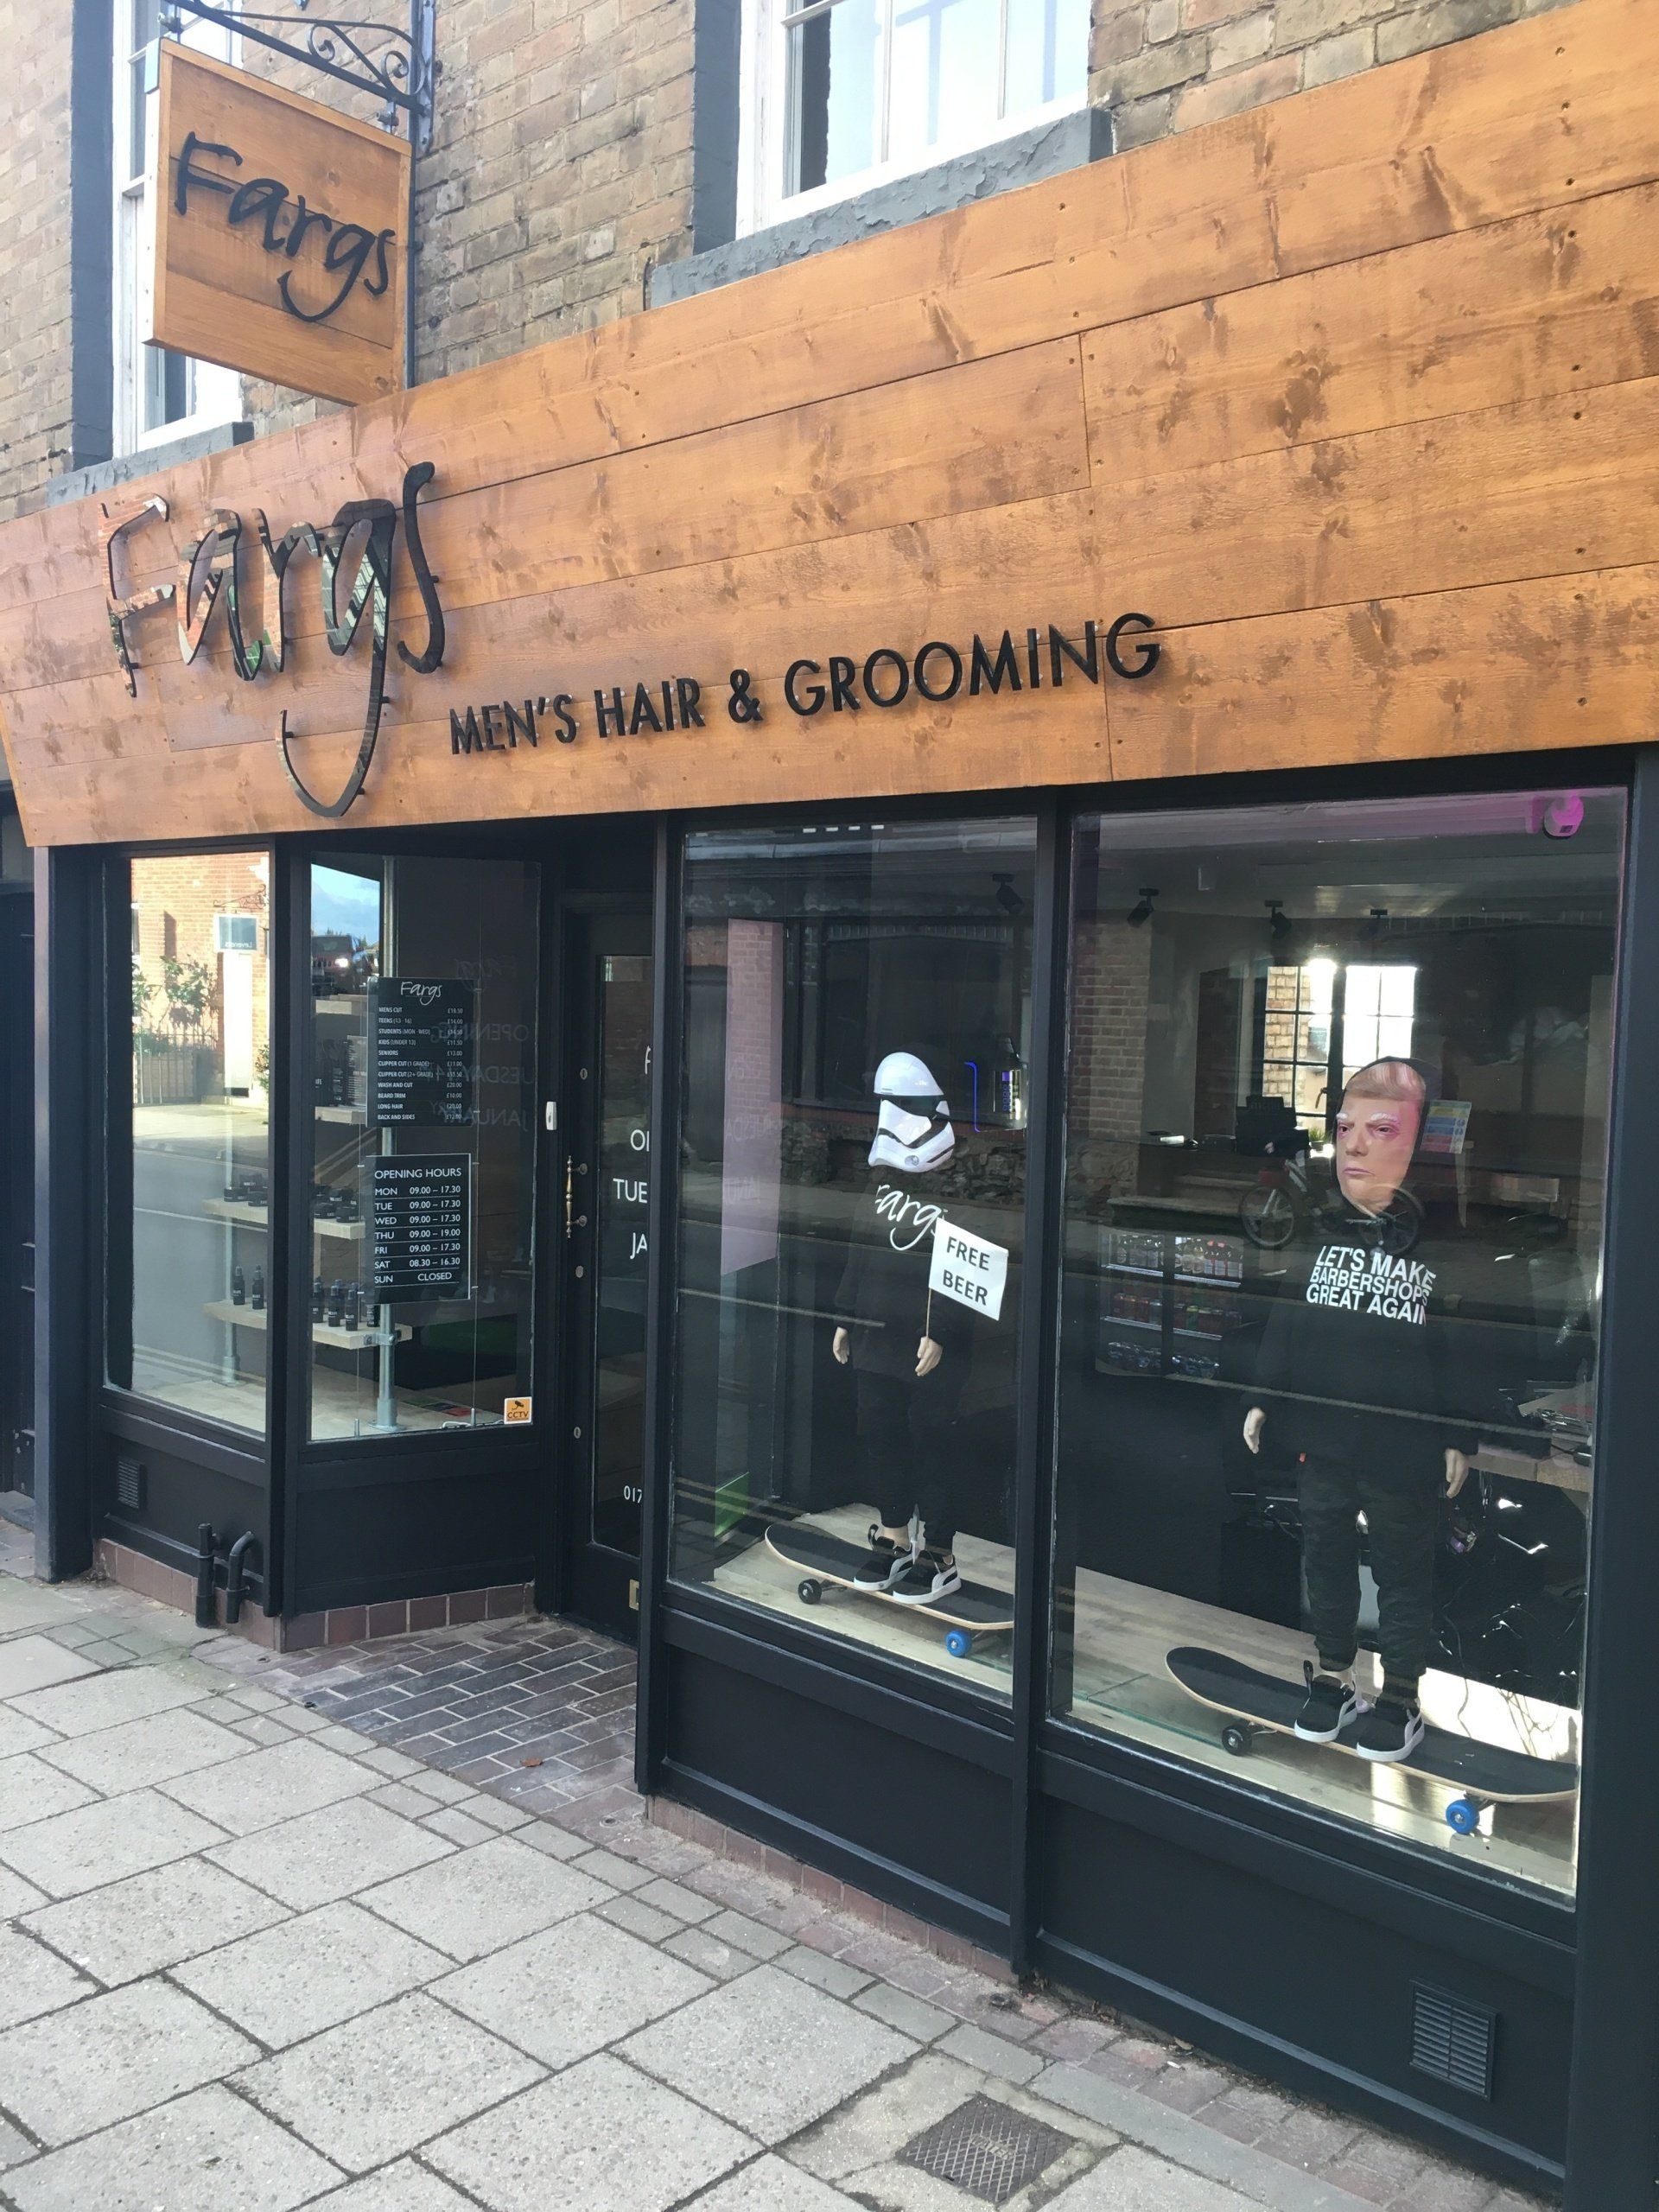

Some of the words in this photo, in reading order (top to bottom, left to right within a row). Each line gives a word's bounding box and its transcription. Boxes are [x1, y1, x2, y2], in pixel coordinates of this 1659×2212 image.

[174, 131, 396, 323] Fargs
[99, 461, 447, 817] Fargs
[449, 694, 577, 755] MEN'S
[594, 677, 705, 739] HAIR
[728, 669, 763, 724] &
[785, 613, 1161, 716] GROOMING
[400, 981, 442, 1006] Fargs
[374, 1168, 423, 1179] OPENING
[425, 1167, 461, 1178] HOURS
[374, 1187, 398, 1196] MON
[410, 1185, 431, 1194] 09.00
[374, 1202, 392, 1211] TUE
[410, 1200, 431, 1209] 09.00
[441, 1199, 461, 1208] 17.30
[874, 1184, 949, 1250] arg
[374, 1217, 397, 1225] WED
[410, 1215, 431, 1224] 09.00
[374, 1231, 395, 1240] THU
[410, 1230, 431, 1238] 09.00
[374, 1246, 388, 1255] FRI
[441, 1243, 461, 1251] 17.30
[946, 1236, 990, 1271] FREE
[374, 1261, 391, 1269] SAT
[410, 1258, 431, 1267] 08.30
[441, 1257, 461, 1266] 16.30
[1315, 1246, 1365, 1272] LET'S
[1370, 1251, 1436, 1291] MAKE
[374, 1275, 393, 1284] SUN
[417, 1272, 452, 1281] CLOSED
[942, 1268, 988, 1306] BEER
[1310, 1267, 1428, 1306] BARBERSHOPS
[1306, 1283, 1365, 1311] GREAT
[624, 1484, 642, 1503] 017
